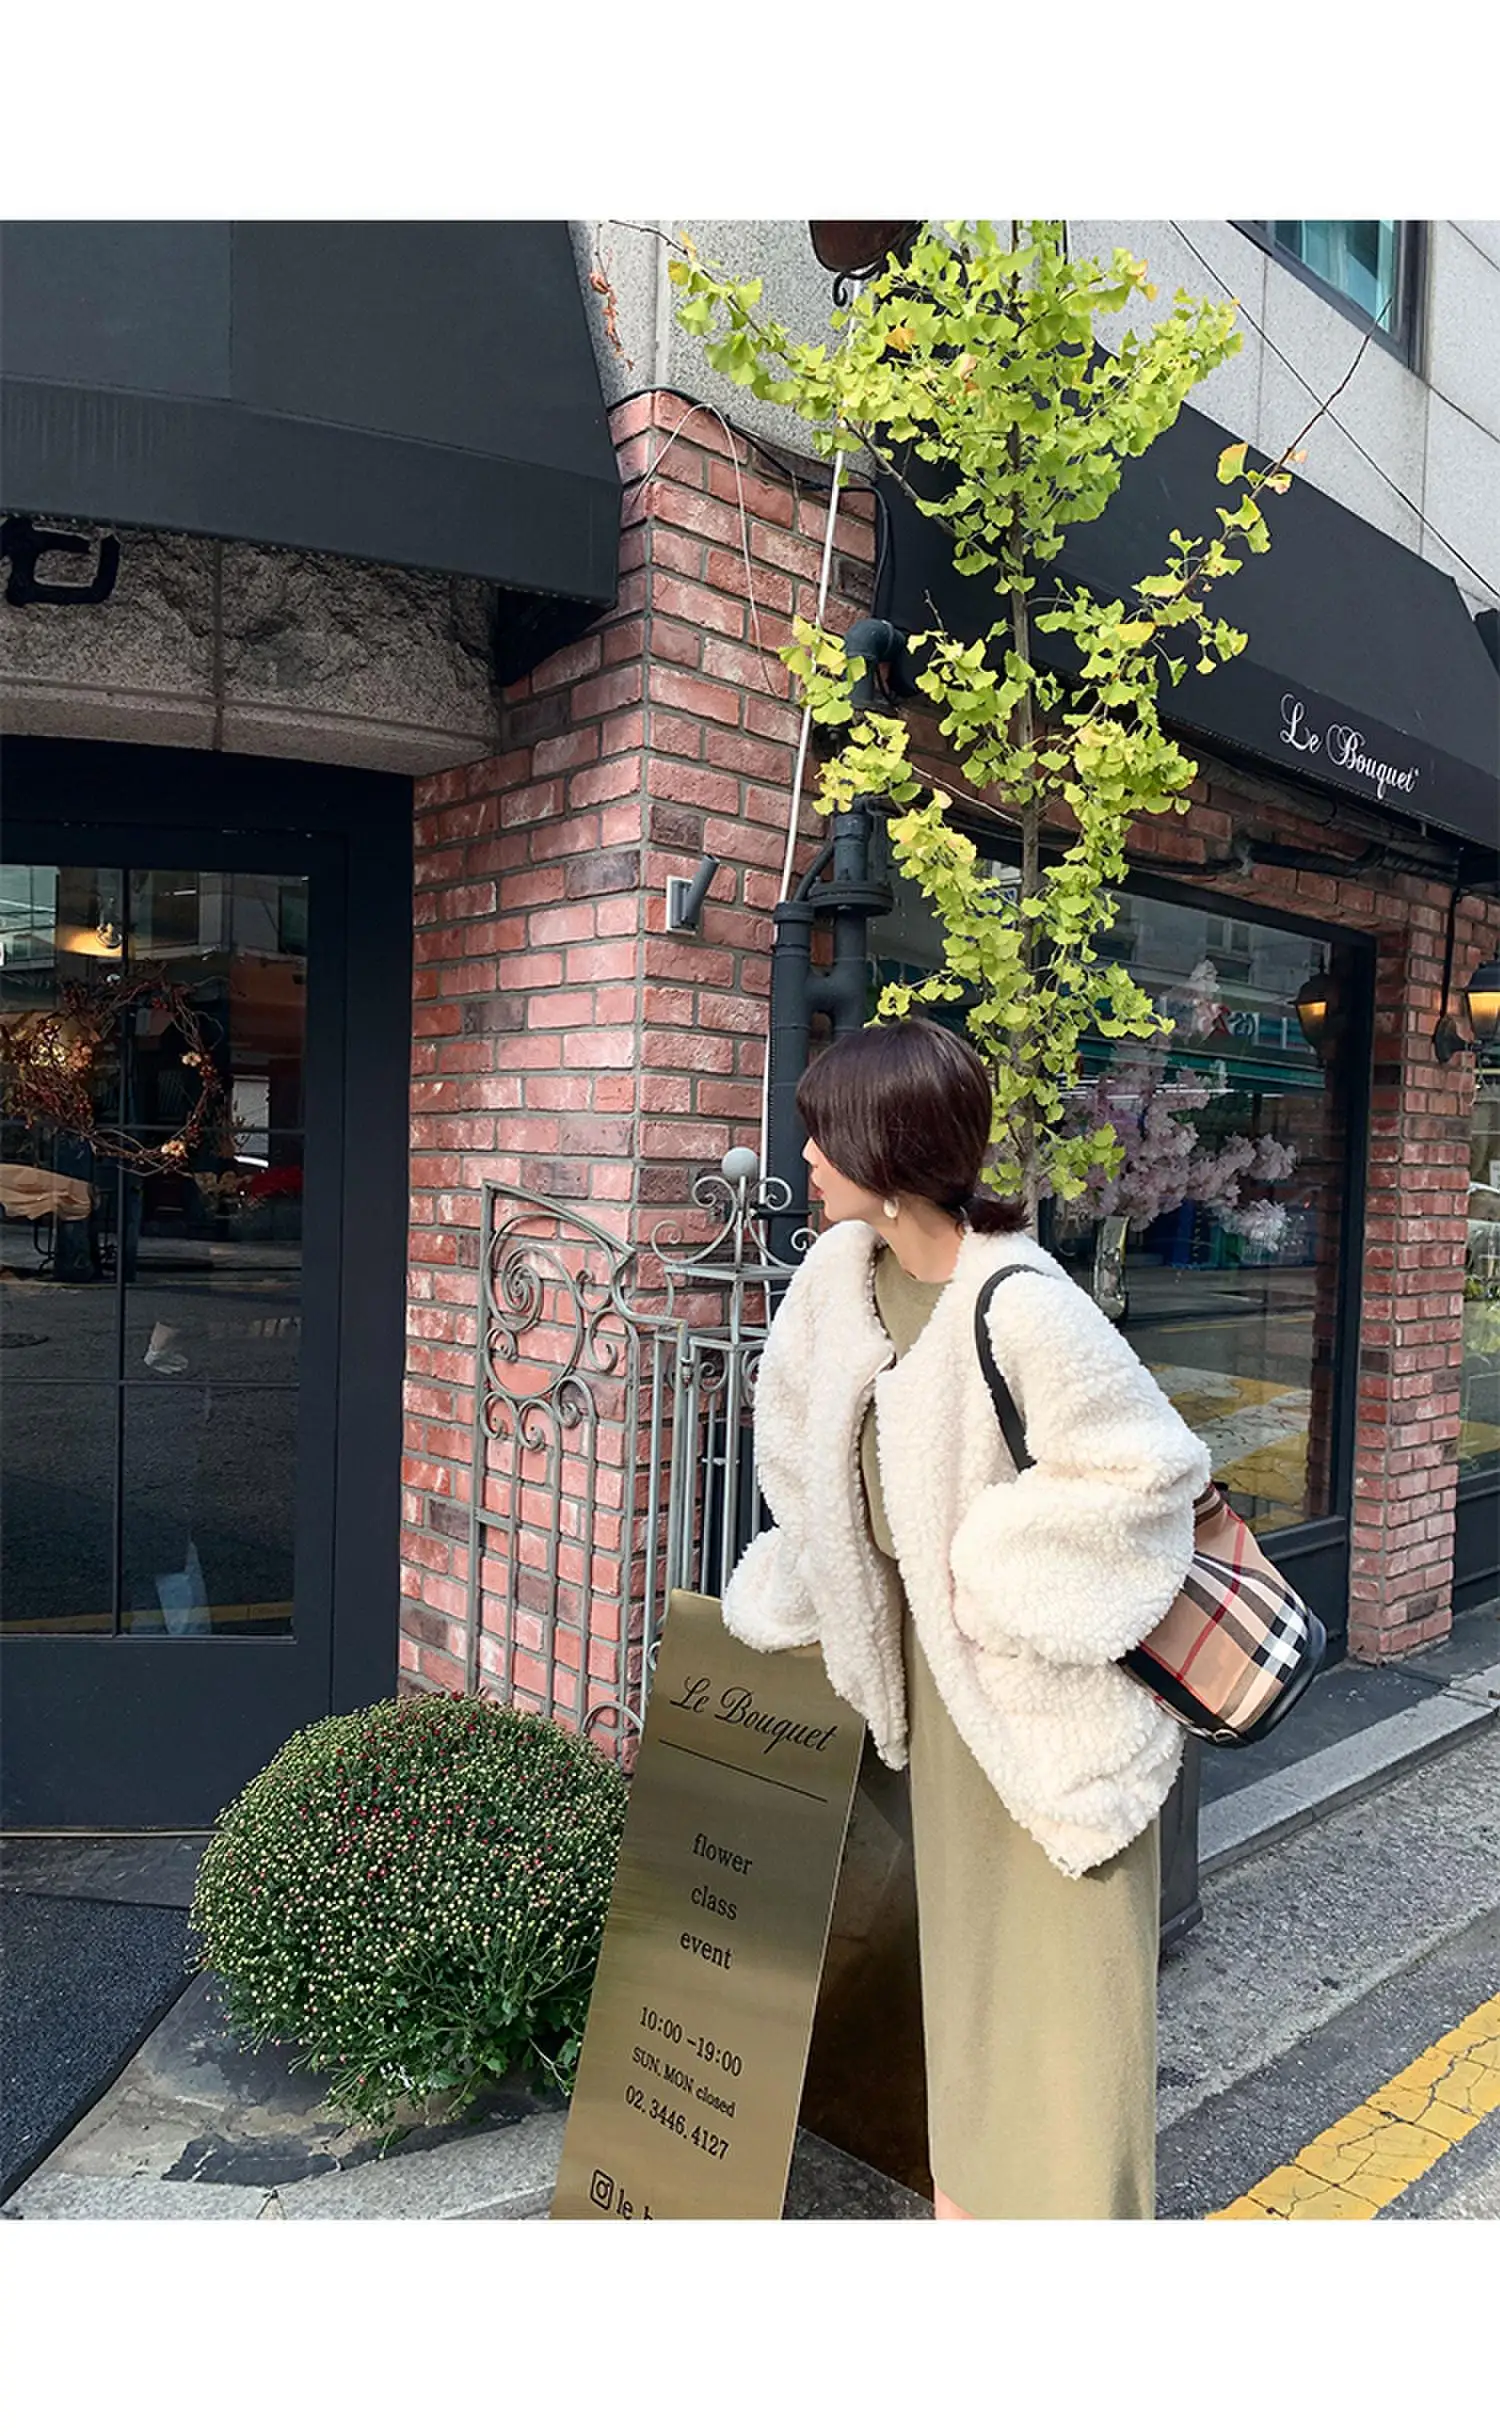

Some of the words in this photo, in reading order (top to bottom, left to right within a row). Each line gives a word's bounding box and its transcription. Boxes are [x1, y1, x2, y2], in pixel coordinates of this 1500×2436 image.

[1280, 693, 1322, 753] Le
[1326, 724, 1418, 799] Bouquet
[669, 1676, 711, 1713] Le
[714, 1686, 838, 1754] Bouquet
[692, 1832, 753, 1875] flower
[691, 1885, 737, 1920] class
[680, 1932, 733, 1970] event
[640, 2006, 683, 2044] 10:00
[695, 2086, 737, 2119] closed
